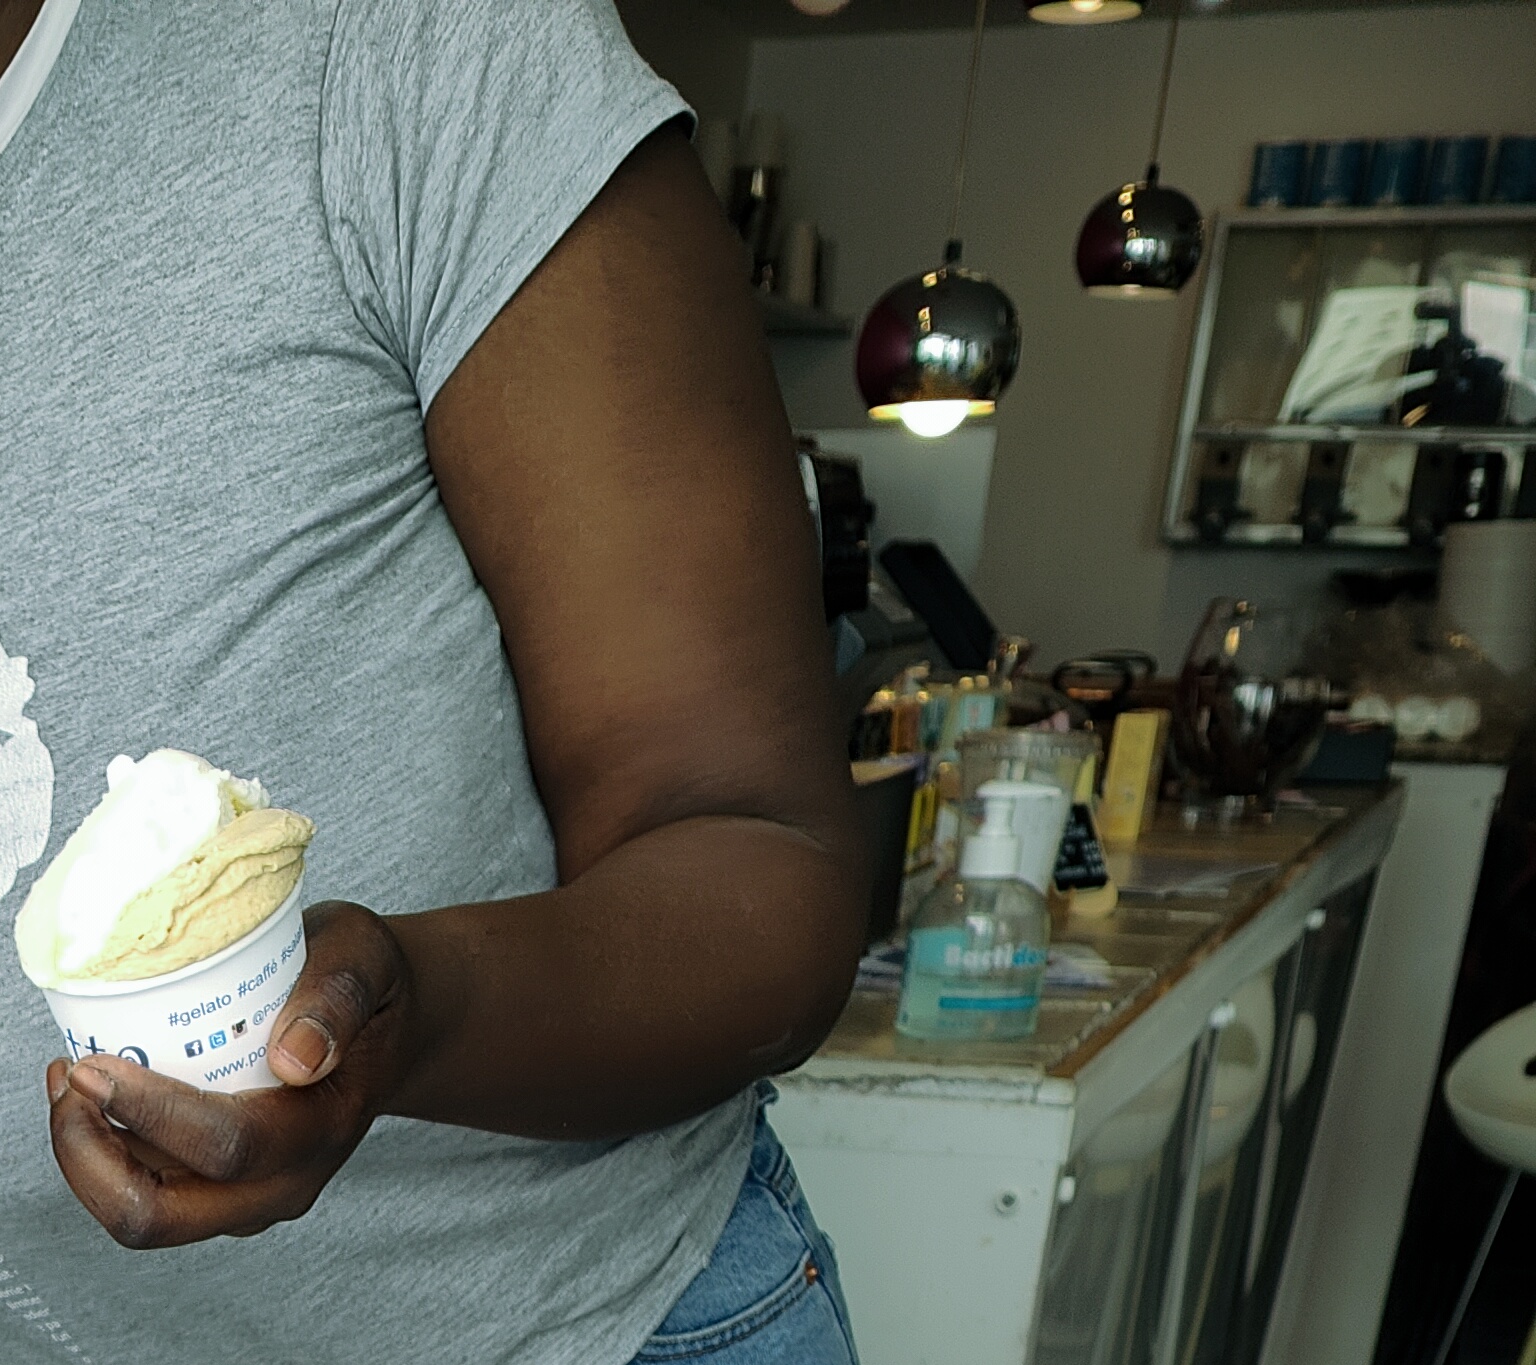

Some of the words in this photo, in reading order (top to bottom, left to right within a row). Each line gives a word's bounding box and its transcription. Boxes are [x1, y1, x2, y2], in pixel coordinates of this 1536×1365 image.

[168, 994, 232, 1027] #gelato
[237, 958, 278, 998] #caffé
[204, 1043, 269, 1083] www.po
